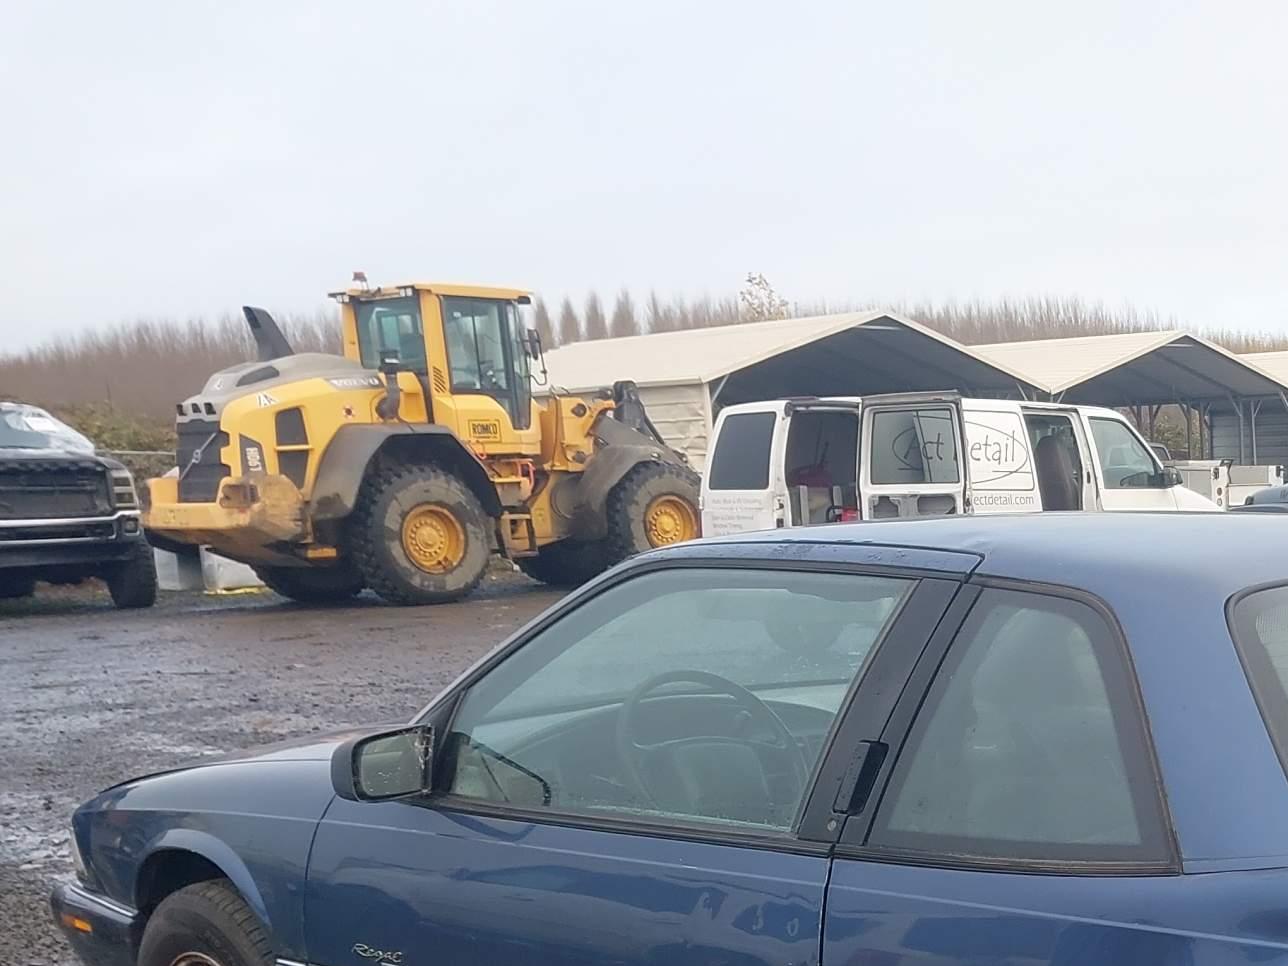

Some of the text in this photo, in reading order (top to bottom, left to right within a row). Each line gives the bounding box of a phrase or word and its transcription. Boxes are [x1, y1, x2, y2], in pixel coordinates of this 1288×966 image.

[472, 423, 497, 434] ROMCO
[970, 430, 1016, 465] etail
[973, 494, 1034, 506] ectdetail.com
